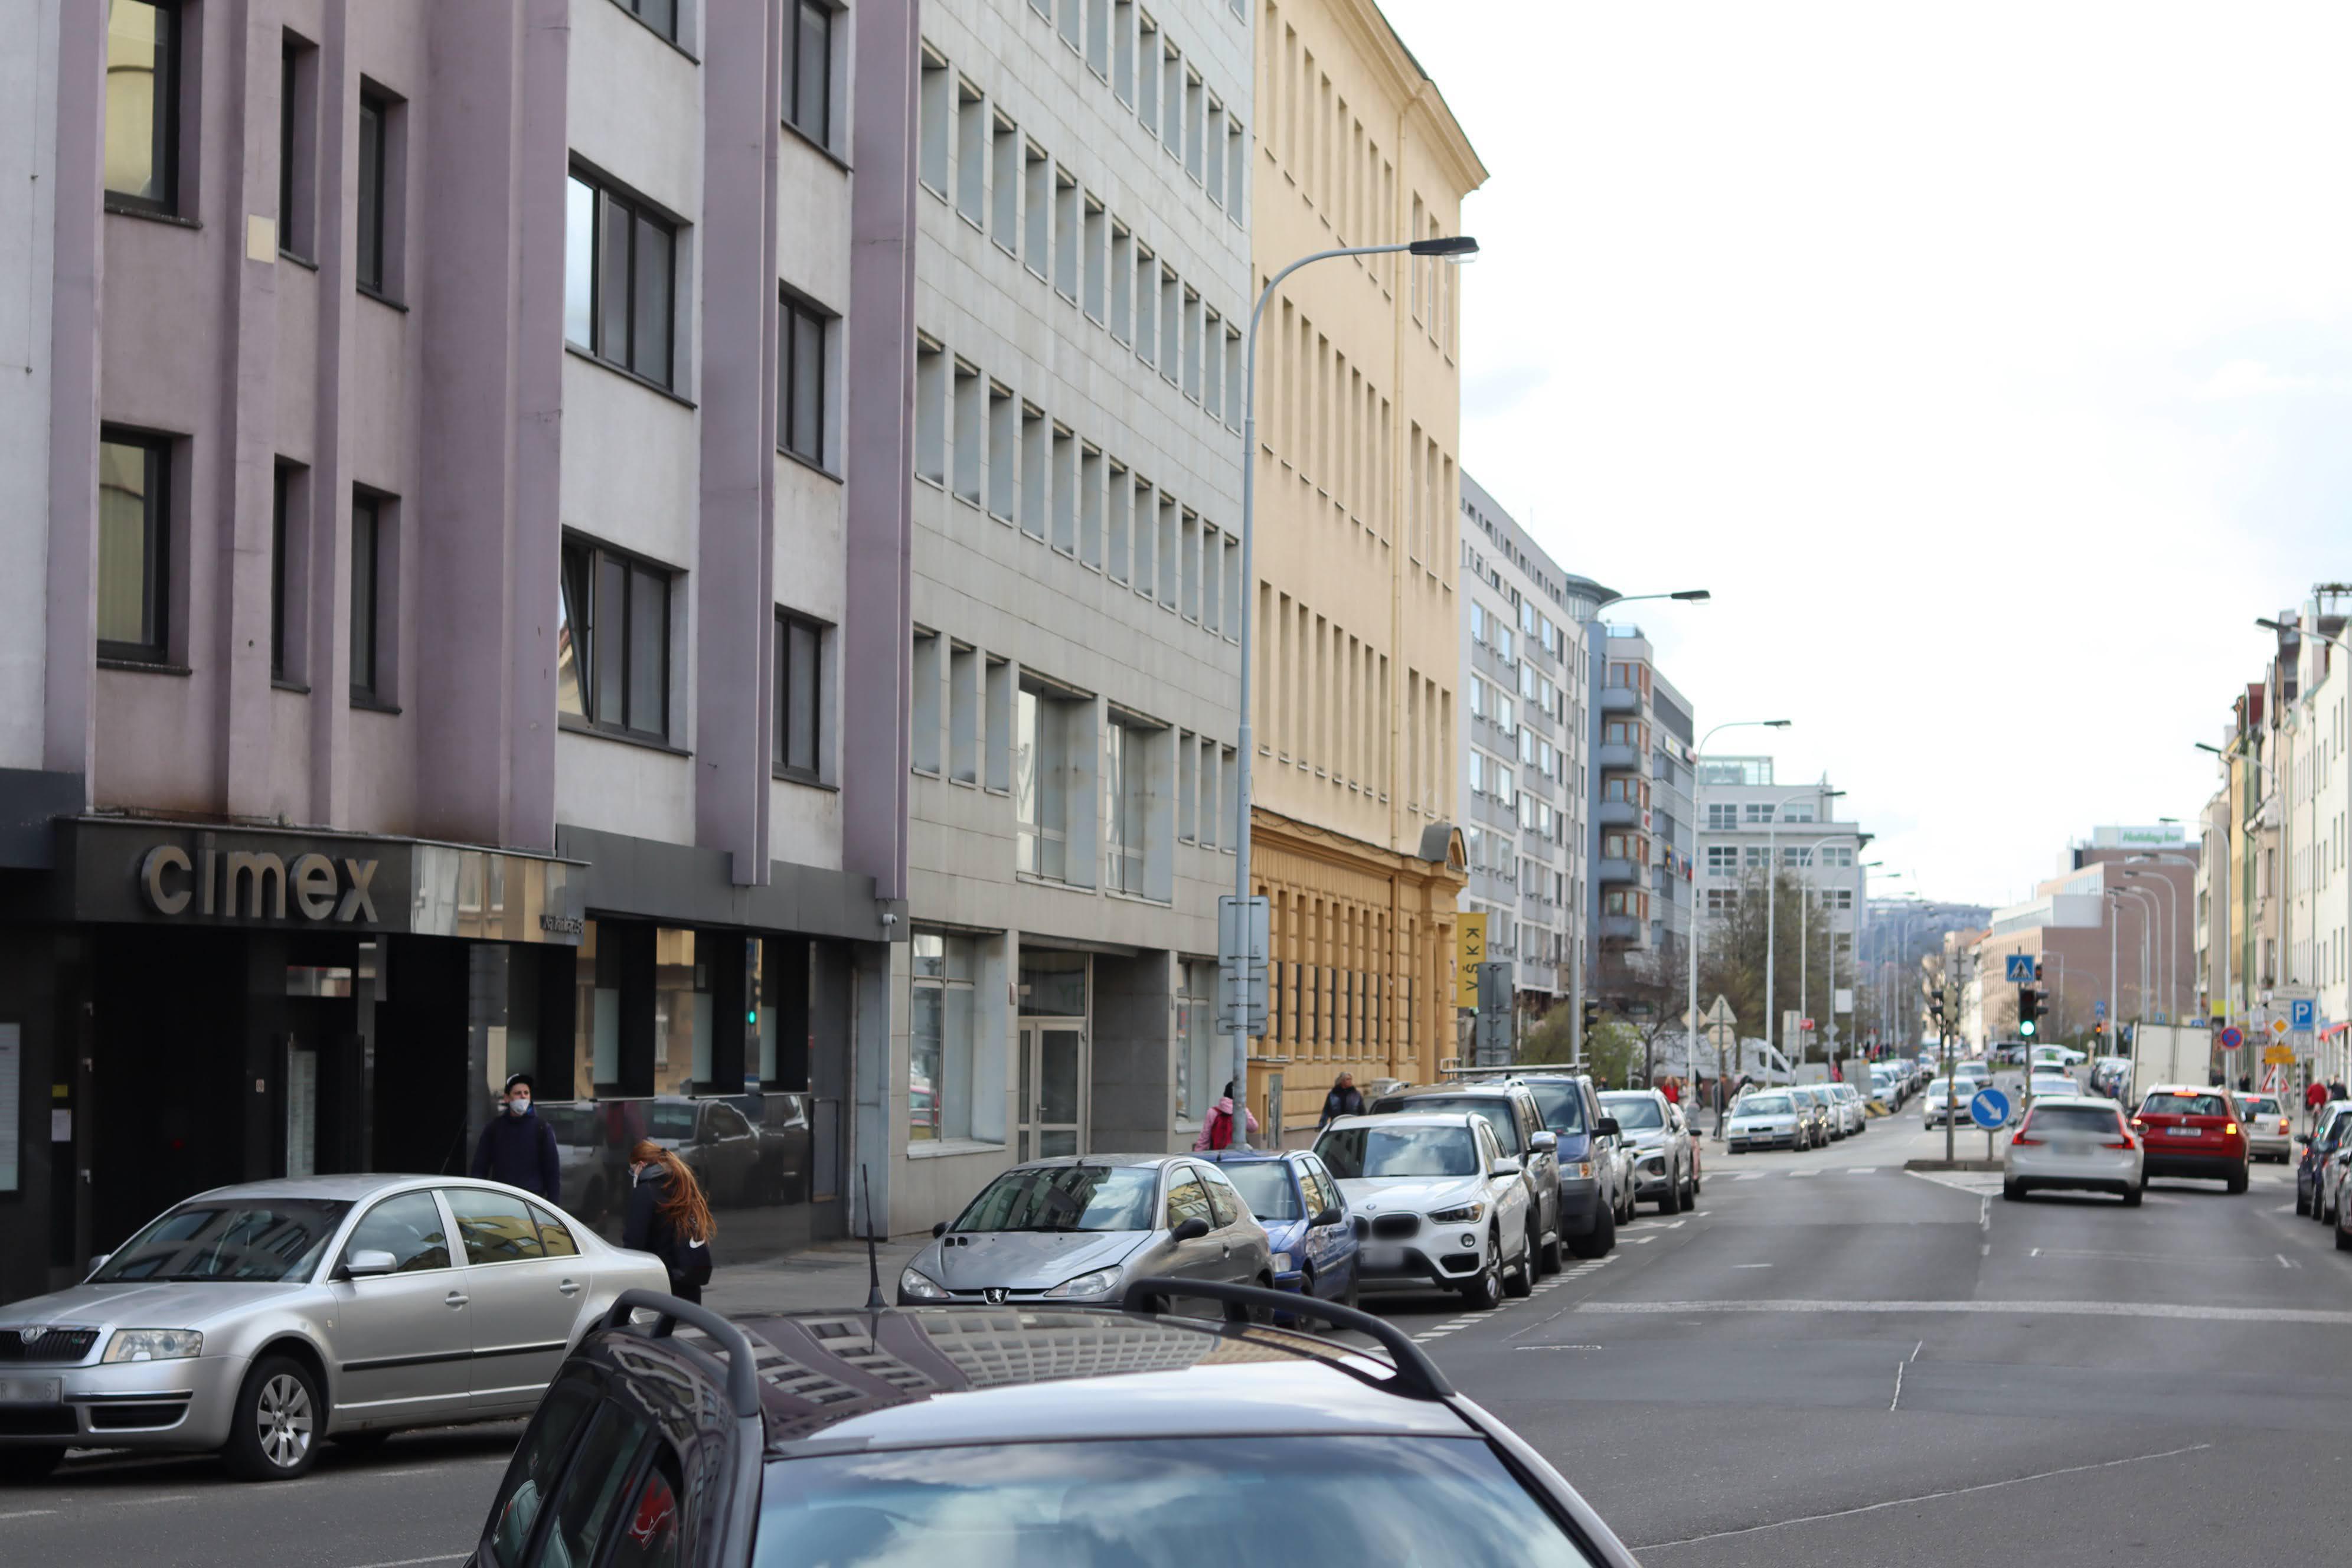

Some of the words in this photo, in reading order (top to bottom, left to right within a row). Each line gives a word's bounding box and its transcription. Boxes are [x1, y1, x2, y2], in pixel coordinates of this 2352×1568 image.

[2123, 831, 2162, 844] Holiday
[2164, 831, 2181, 842] Inn
[141, 831, 378, 922] cimex
[1462, 927, 1480, 991] VŠKK
[2295, 1003, 2309, 1023] P
